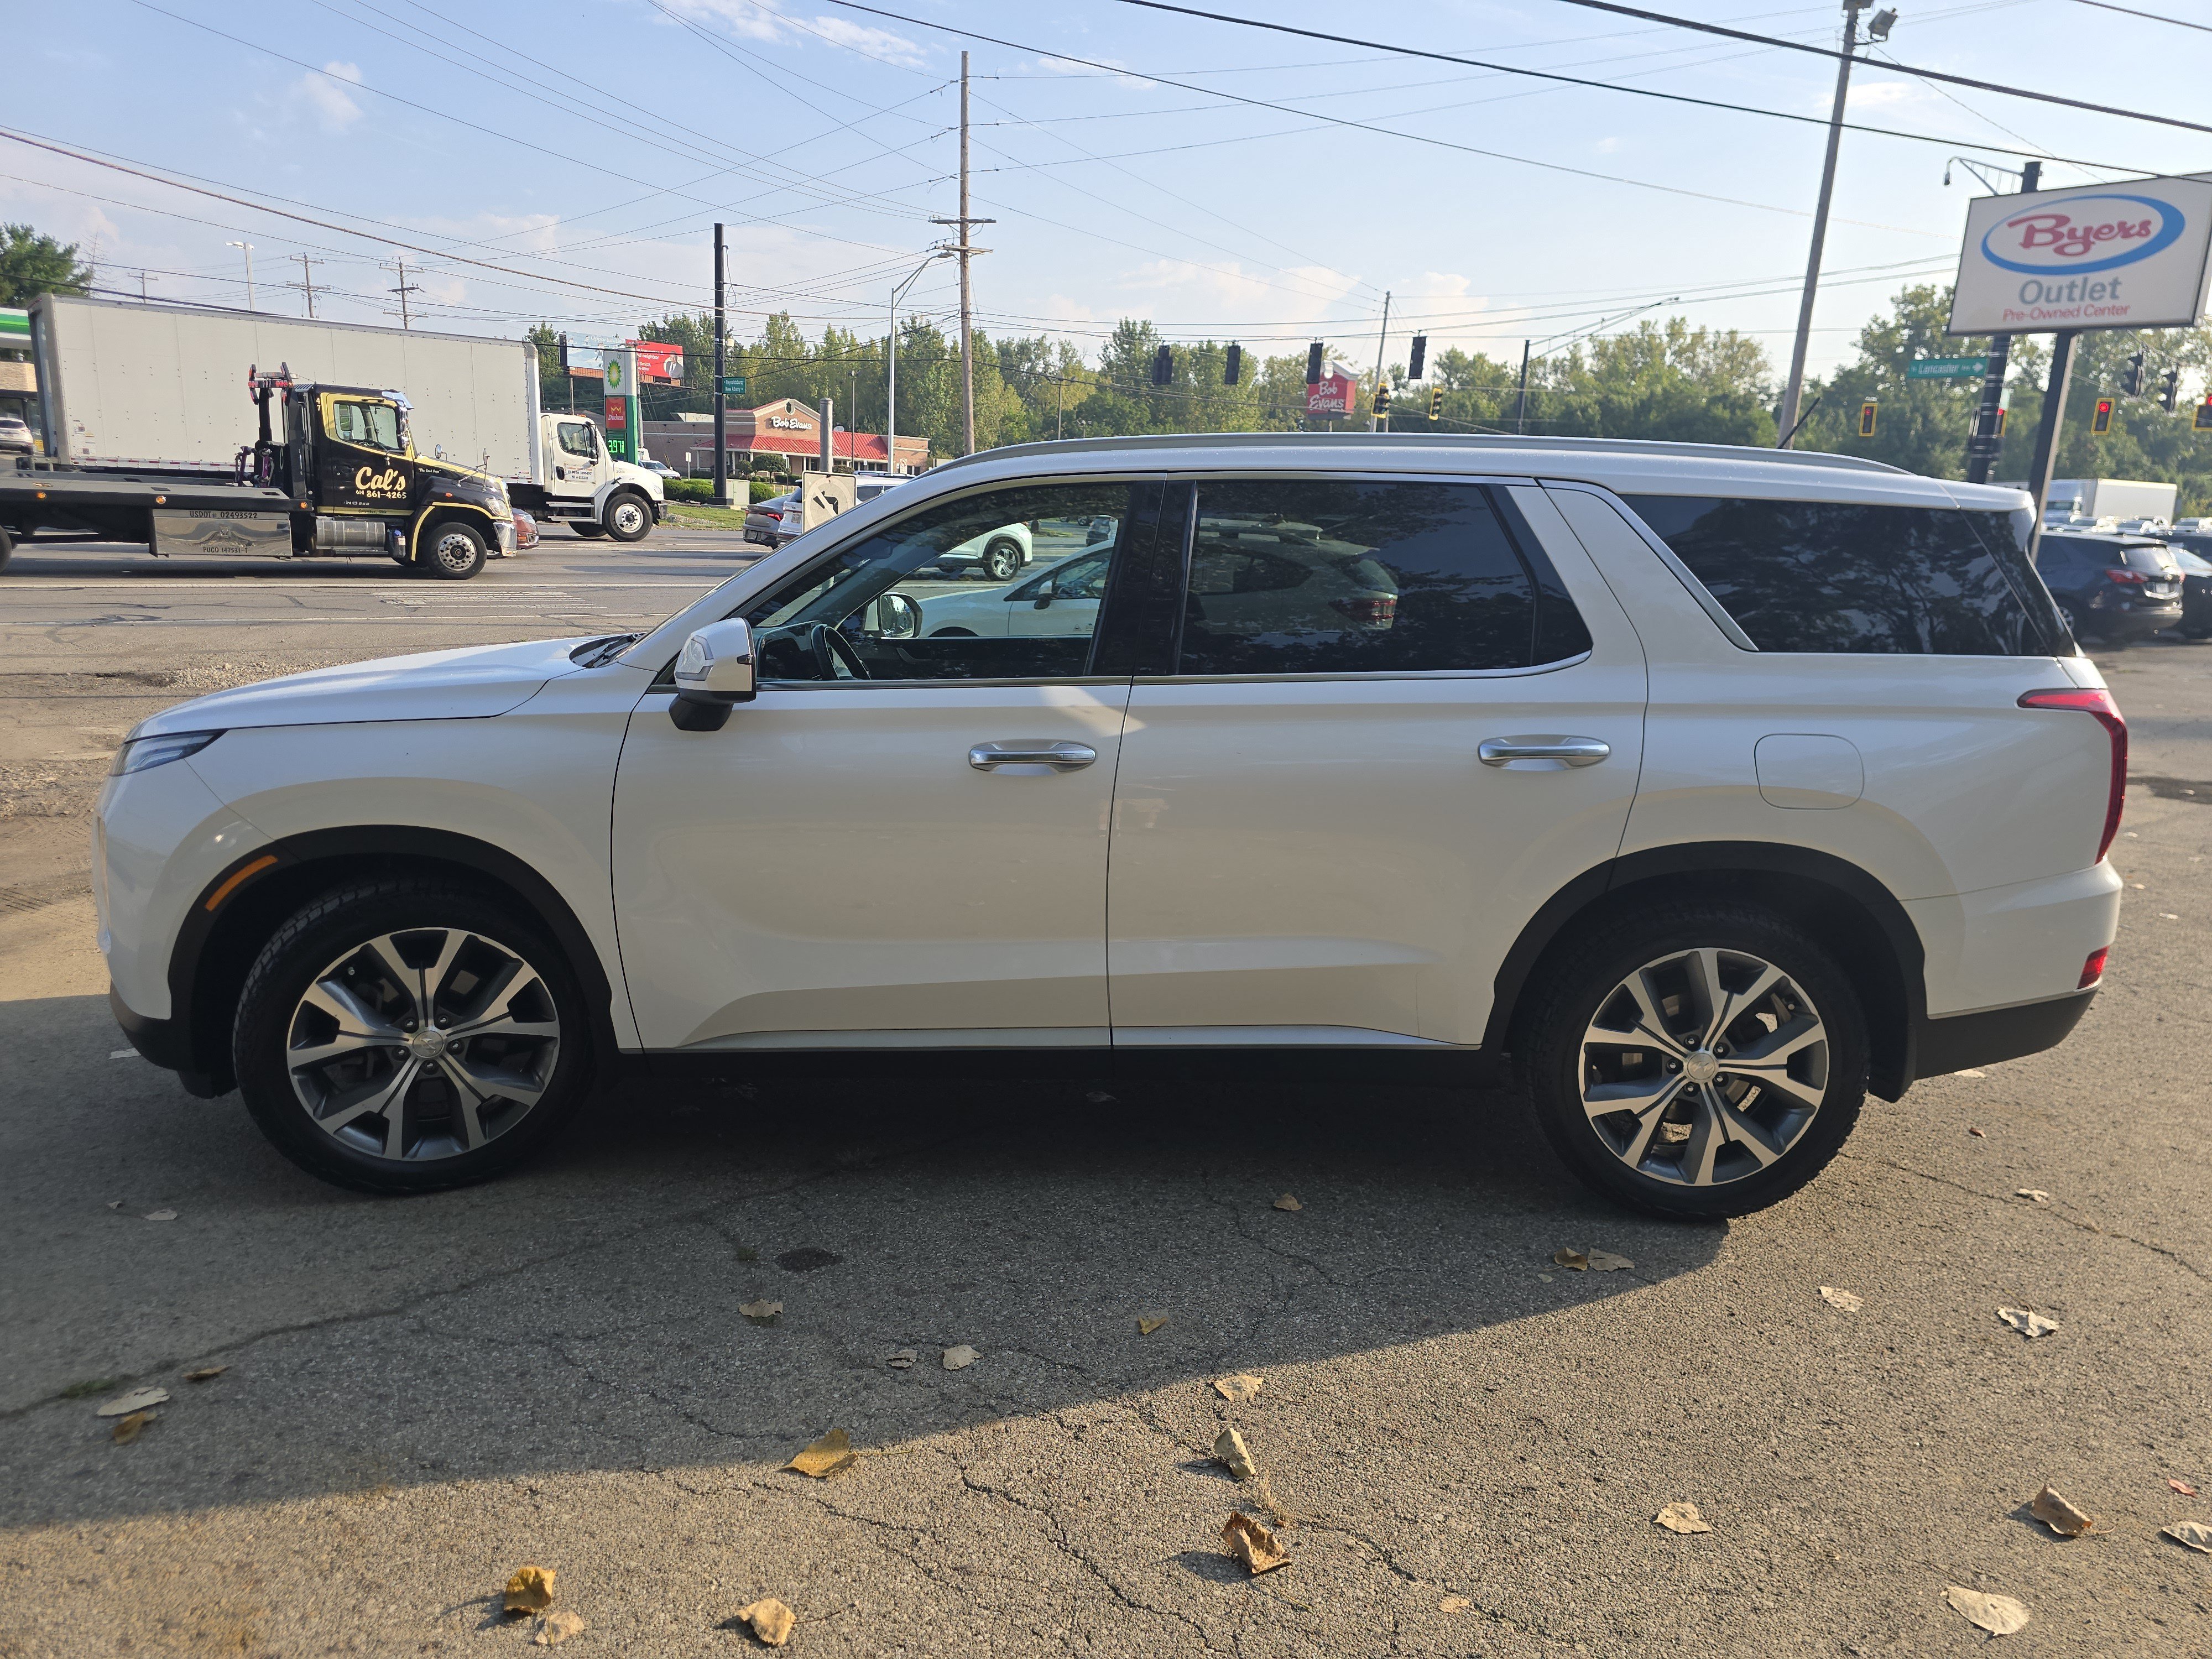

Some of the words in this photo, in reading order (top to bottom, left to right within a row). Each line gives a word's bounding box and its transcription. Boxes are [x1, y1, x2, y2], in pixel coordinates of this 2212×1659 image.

[2006, 213, 2152, 257] Byers
[2019, 276, 2122, 305] Outlet
[2001, 305, 2081, 322] Pre-Owned
[2083, 304, 2131, 318] Center
[1918, 363, 1960, 374] Lancaster
[1318, 381, 1338, 395] Bob
[1309, 394, 1345, 410] Evans
[771, 415, 790, 428] Bob
[789, 418, 812, 430] Evans
[355, 466, 406, 491] Cal's
[366, 490, 407, 499] 861-4265
